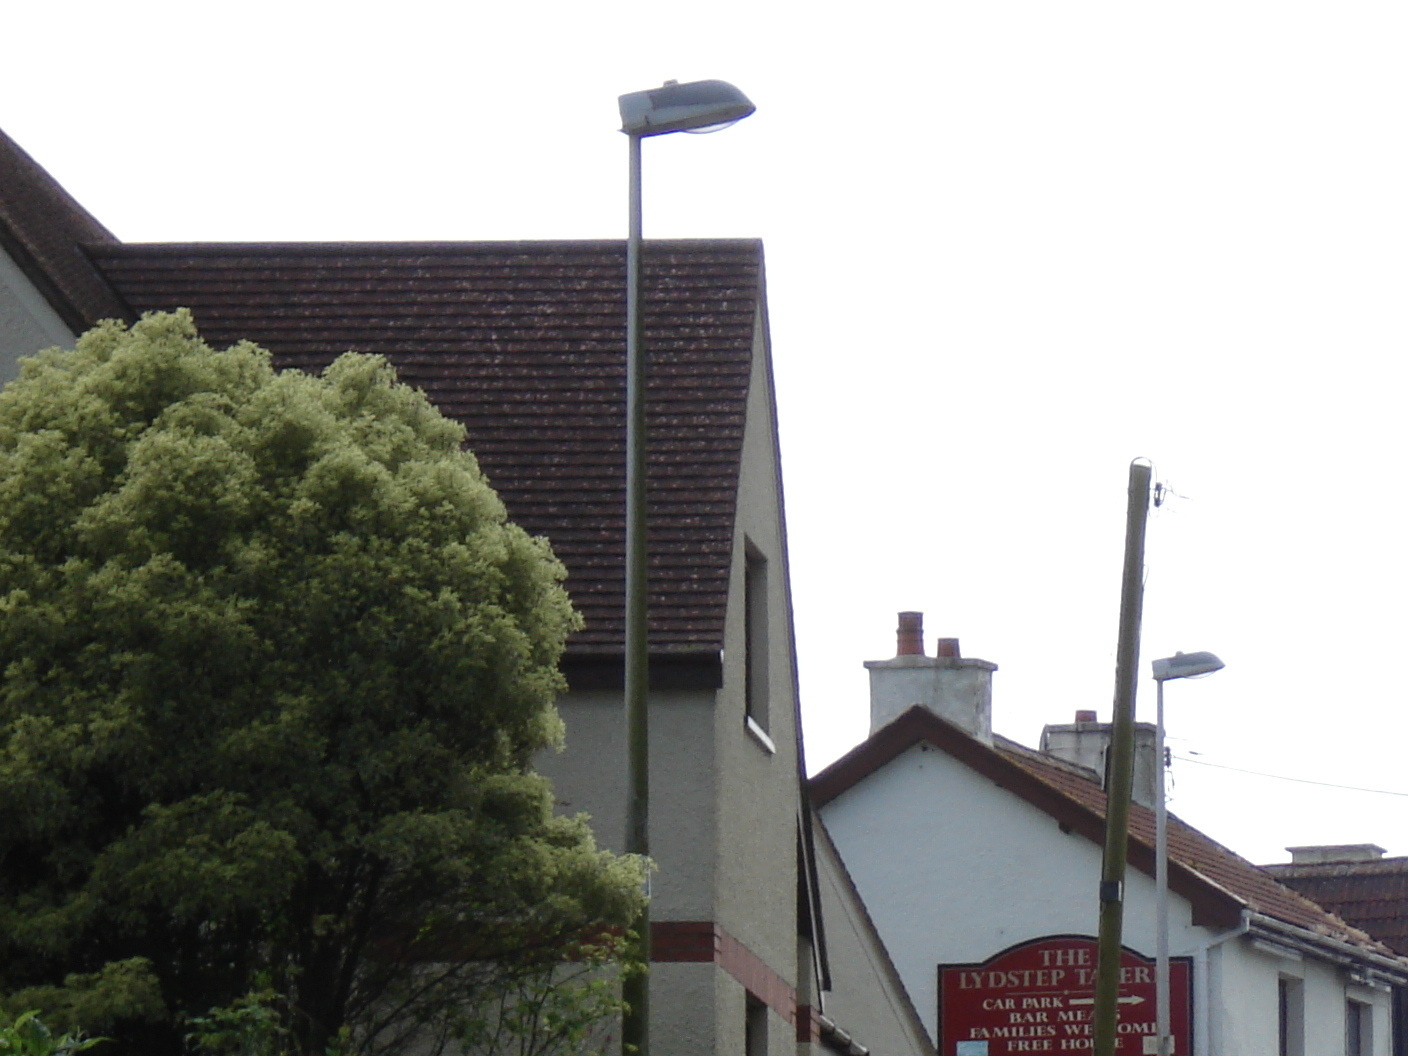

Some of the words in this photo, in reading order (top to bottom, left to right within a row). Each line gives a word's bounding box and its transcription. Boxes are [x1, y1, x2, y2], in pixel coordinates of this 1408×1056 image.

[1039, 949, 1091, 966] THE
[959, 969, 1065, 989] LYDSTEP
[1074, 967, 1171, 986] TAER
[982, 998, 1016, 1010] CAR
[1022, 997, 1064, 1009] PARK
[1009, 1012, 1048, 1024] BAR
[970, 1025, 1056, 1039] FAMILIES
[1064, 1022, 1158, 1035] WEOM
[1007, 1040, 1053, 1052] FREE
[1061, 1037, 1124, 1050] HOE
